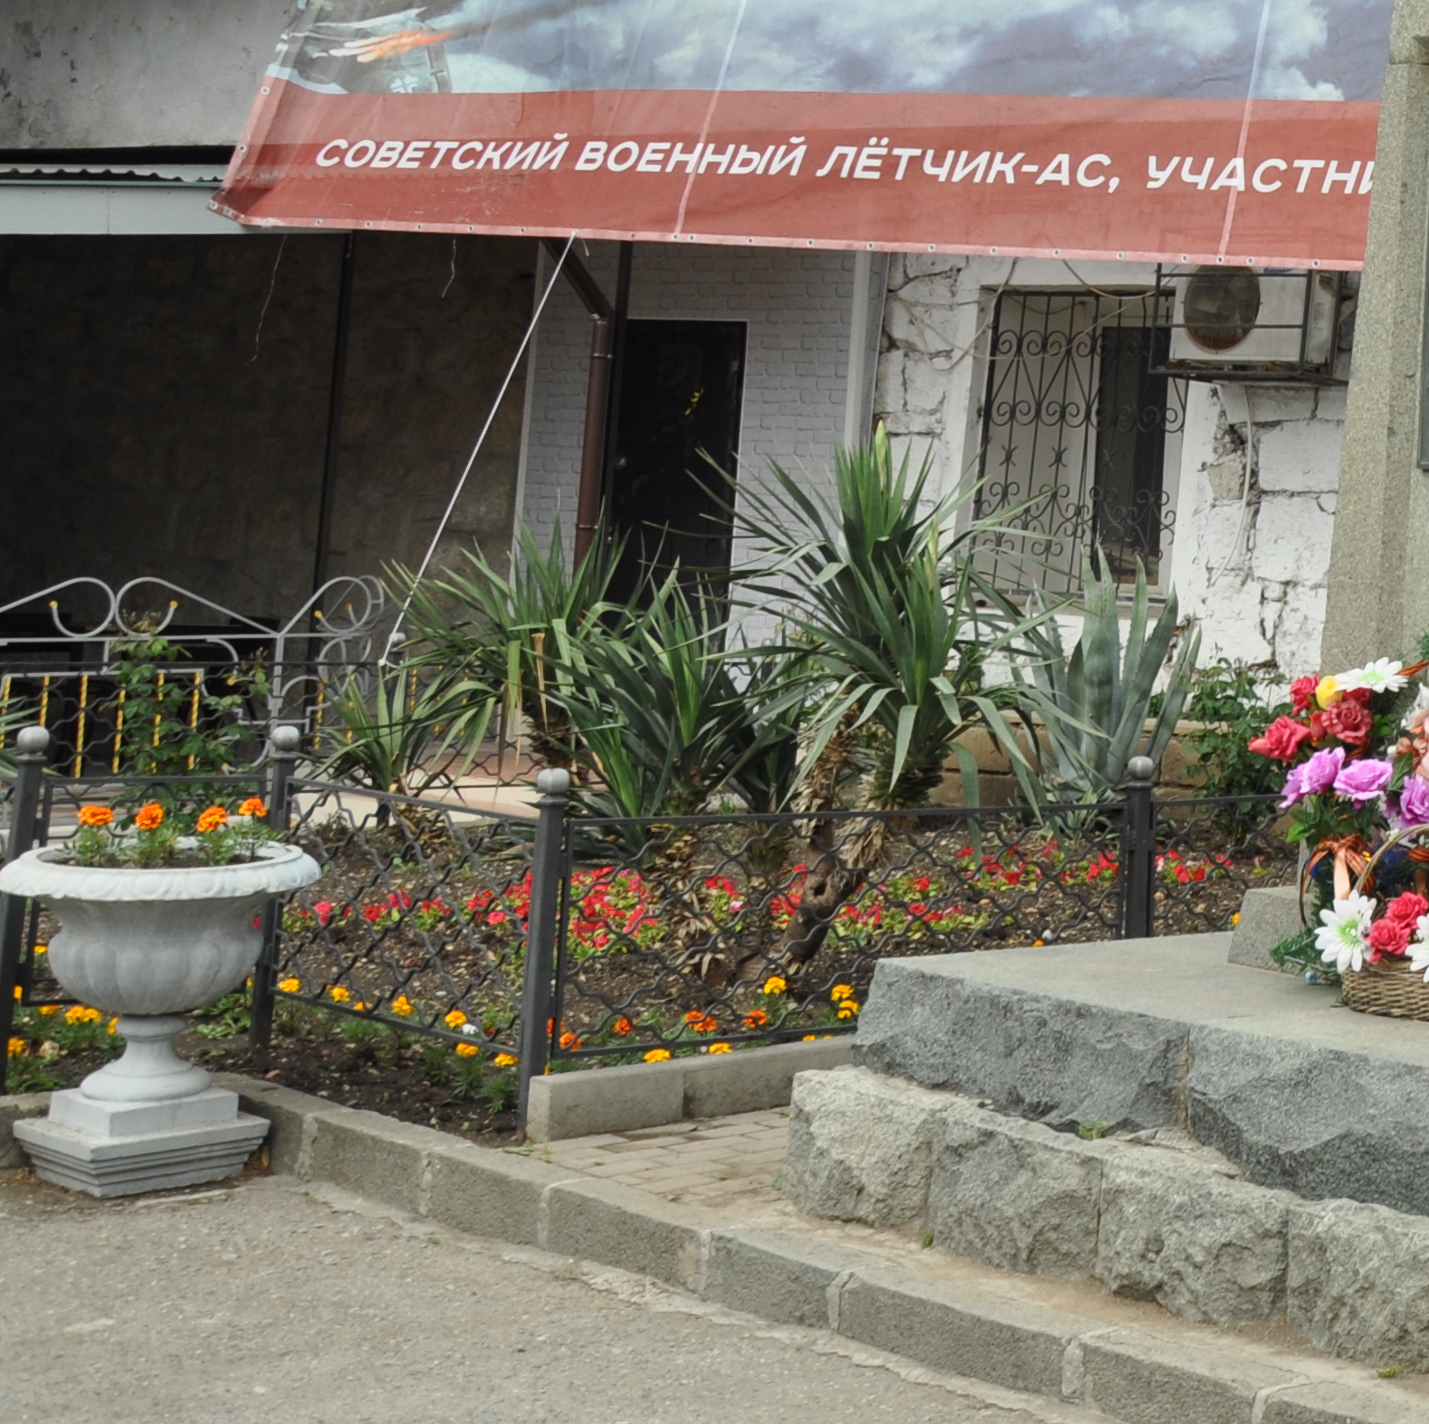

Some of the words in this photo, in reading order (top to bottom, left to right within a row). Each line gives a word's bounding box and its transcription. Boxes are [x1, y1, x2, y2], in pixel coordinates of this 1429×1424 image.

[315, 133, 568, 171] СОВЕТСКИЙ
[574, 137, 809, 175] ВОЕННЫЙ
[816, 137, 1121, 193] ЛЁТЧИК-АС,
